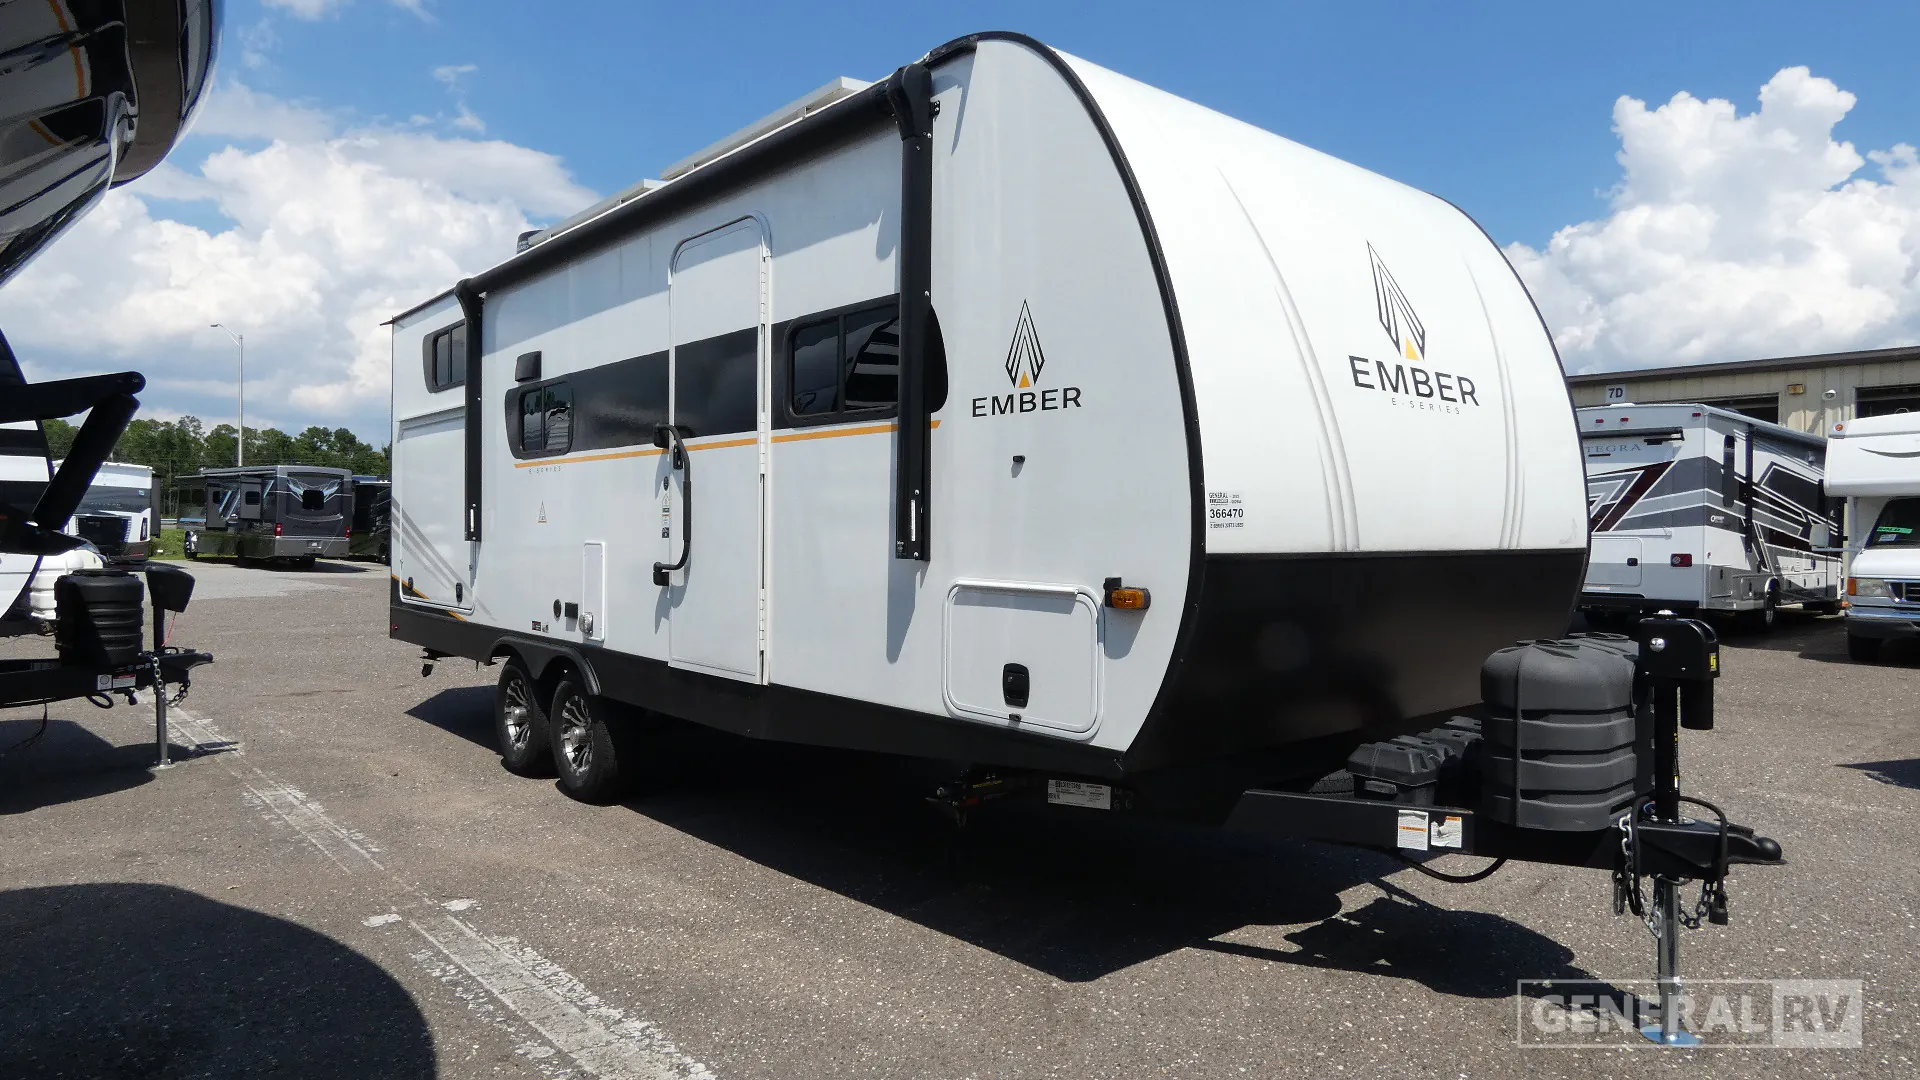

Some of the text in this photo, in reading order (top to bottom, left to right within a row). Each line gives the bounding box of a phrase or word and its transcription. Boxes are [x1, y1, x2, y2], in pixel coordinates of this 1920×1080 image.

[1348, 355, 1480, 407] EMBER
[972, 387, 1082, 418] EMBER
[1608, 388, 1623, 398] 7D
[1209, 508, 1244, 519] 366470
